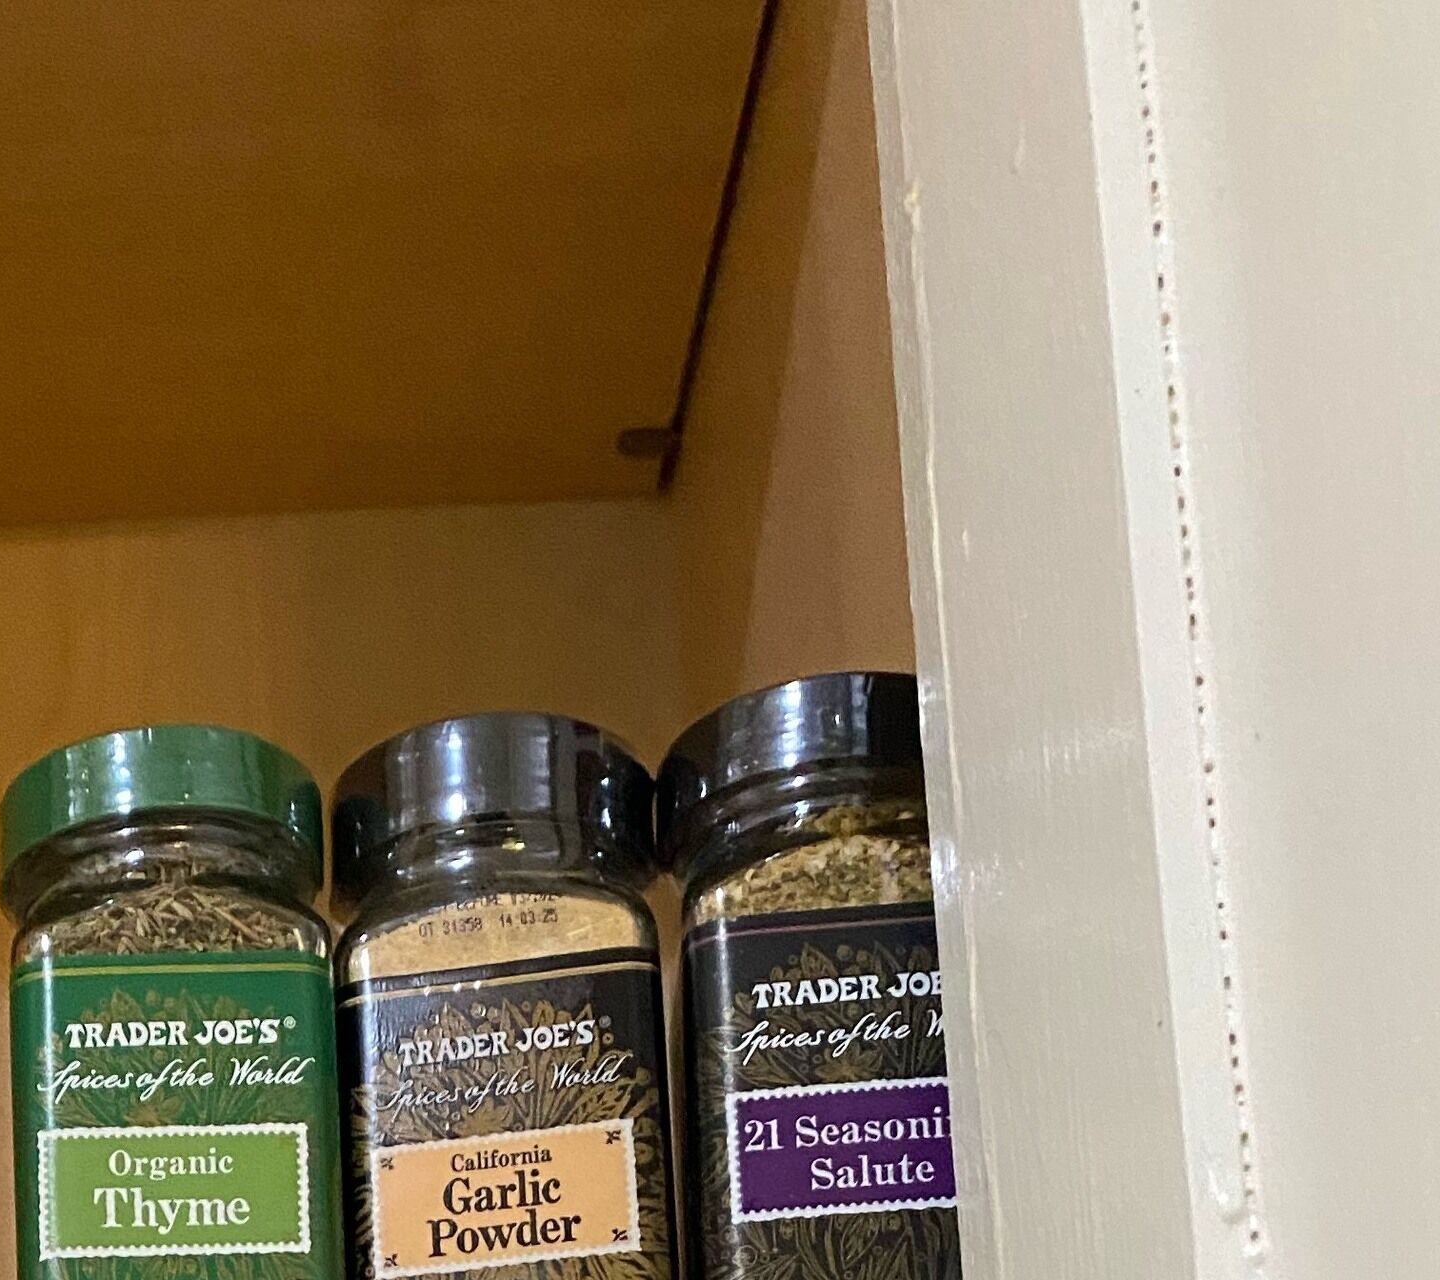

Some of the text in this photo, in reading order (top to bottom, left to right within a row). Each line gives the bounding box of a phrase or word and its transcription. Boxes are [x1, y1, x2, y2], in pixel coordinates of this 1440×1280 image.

[752, 976, 882, 1009] TRADER
[65, 1020, 189, 1049] TRADER
[399, 1032, 510, 1068] TRADER
[725, 1021, 825, 1065] Spices
[38, 1060, 132, 1102] Spices
[228, 1058, 315, 1085] World
[378, 1079, 462, 1122] Spices
[551, 1055, 626, 1089] World
[744, 1106, 952, 1152] 21 Seasoni
[108, 1147, 234, 1181] Organic
[451, 1144, 552, 1173] California
[810, 1151, 935, 1191] Salute
[94, 1186, 250, 1235] Thyme
[442, 1168, 561, 1216] Garlic
[428, 1208, 581, 1258] Powder
